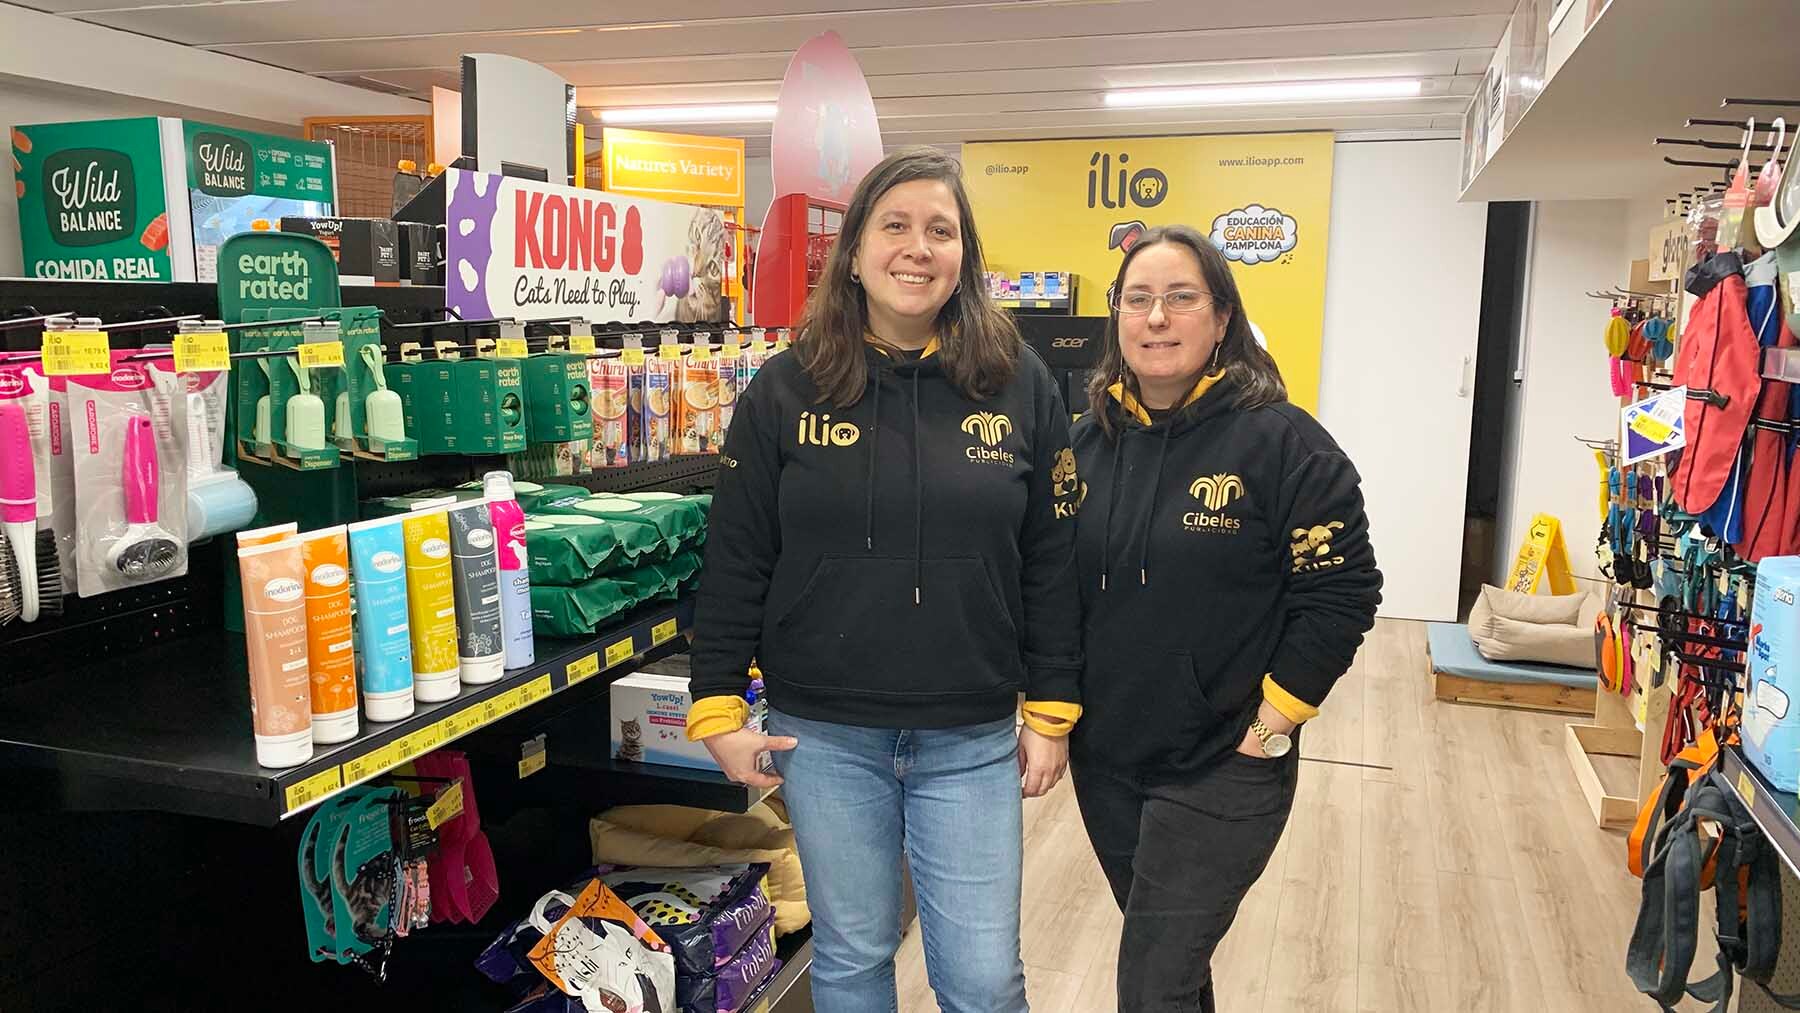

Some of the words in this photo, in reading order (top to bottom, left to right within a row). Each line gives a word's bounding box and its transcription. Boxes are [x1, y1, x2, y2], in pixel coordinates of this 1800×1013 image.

[200, 144, 245, 172] Wild
[1219, 155, 1304, 168] www.ilioapp.com
[679, 159, 733, 182] Variety
[985, 163, 1029, 176] @ilio.app
[52, 160, 122, 210] Wild
[204, 172, 246, 191] BALANCE
[60, 209, 122, 234] BALANCE
[310, 220, 343, 232] YowUp!
[1227, 214, 1284, 226] EDUCACIÓN
[514, 189, 617, 273] KONG
[1223, 225, 1285, 241] CANINA
[1225, 241, 1284, 251] PAMPLONA
[35, 259, 107, 281] COMIDA
[114, 257, 160, 279] REAL
[239, 251, 309, 278] earth
[240, 276, 310, 301] rated
[514, 275, 552, 307] Cats
[554, 278, 593, 306] Need
[593, 280, 606, 306] to
[608, 283, 641, 317] Play.
[1052, 336, 1089, 349] acer
[498, 367, 520, 377] earth
[566, 361, 586, 371] earth
[591, 359, 625, 375] Churu
[499, 377, 521, 387] rated
[567, 371, 586, 380] rated
[966, 447, 1015, 464] Cibeles
[1183, 512, 1241, 530] Cibeles
[651, 692, 684, 705] YowUp!
